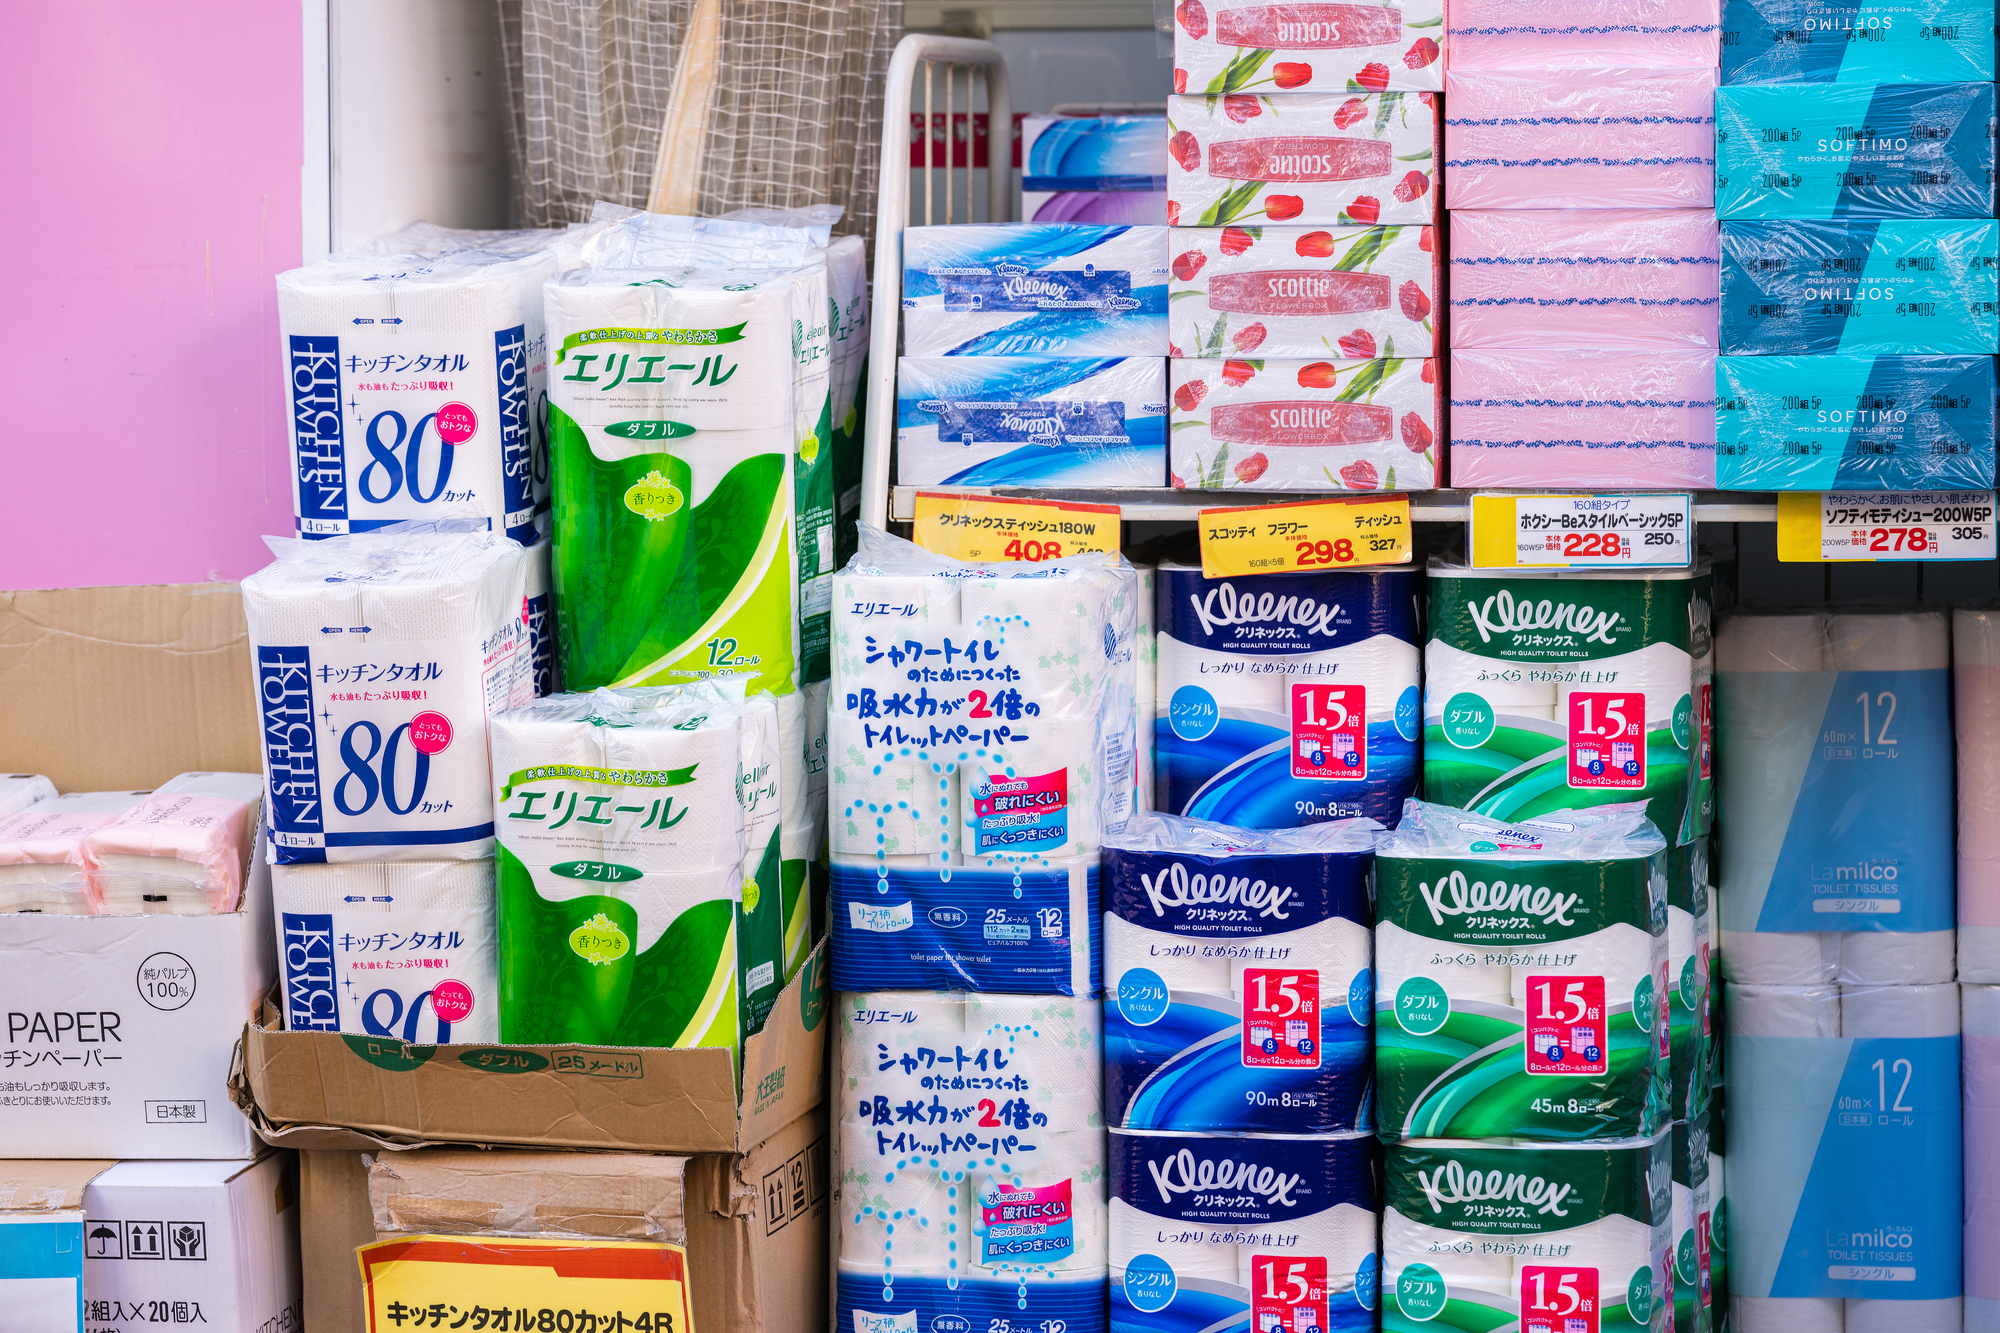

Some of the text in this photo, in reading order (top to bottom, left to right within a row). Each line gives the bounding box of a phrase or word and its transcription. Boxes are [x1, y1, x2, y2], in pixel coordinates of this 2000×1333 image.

[1804, 17, 1892, 30] SOFTIMO
[1818, 139, 1908, 151] SOFTIMO
[1003, 277, 1070, 301] Kleenex
[1805, 288, 1894, 300] SOFTIMO
[344, 354, 470, 374] キッチンタオル
[562, 354, 738, 392] エリエール
[358, 381, 454, 391] 水も油もたっぷり吸収！
[292, 342, 321, 484] TOWELS
[444, 412, 468, 422] とっても
[1817, 410, 1907, 423] SOFTIMO
[311, 349, 344, 512] KITCHEN
[440, 420, 472, 432] おトクな
[627, 422, 675, 436] ダブル
[1000, 412, 1065, 435] Kleenex
[1812, 441, 1822, 454] 5P
[358, 410, 455, 504] 80
[442, 489, 476, 502] カット
[633, 492, 675, 506] 香りつき
[1828, 494, 1990, 505] やわらかく、お肌にやさしい肌ざわり
[1573, 499, 1630, 510] 160組タイプ
[1520, 513, 1683, 529] ホクシーBeスタイルベーシック5P
[1826, 507, 1992, 524] ソフティモティシュー200W5P
[306, 521, 340, 532] 4ロール
[940, 513, 1096, 535] クリネックスティッシュ180W
[1209, 514, 1402, 540] スコッティ フラワー ティッシュ
[1644, 532, 1674, 545] 250
[1870, 528, 1928, 551] 278
[1952, 527, 1982, 539] 305
[1004, 539, 1062, 562] 408
[1295, 538, 1354, 566] 298
[1370, 538, 1396, 551] 327
[1545, 543, 1561, 551] 価格
[1563, 533, 1620, 557] 228
[1929, 542, 1938, 553] 円
[1622, 548, 1631, 558] 円
[1248, 557, 1285, 568] 160組×5個
[851, 602, 919, 618] エリエール
[1191, 582, 1341, 636] Kleenex
[1468, 589, 1620, 644] Kleenex
[1234, 627, 1297, 639] クリネックス
[1512, 634, 1574, 647] クリネックス
[865, 636, 1000, 667] シャワートイレ
[316, 662, 443, 684] キッチンタオル
[908, 665, 1021, 683] のためにつくった
[1200, 662, 1339, 675] しっかり なめらか 仕上げ
[1477, 670, 1618, 684] ふっくら やわらか 仕上げ
[330, 690, 427, 702] 水も油もたっぷり吸収！
[847, 687, 1040, 721] 吸水力が2倍の
[1172, 702, 1215, 716] シングル
[1299, 690, 1360, 731] 1.5 倍
[1450, 709, 1486, 724] ダブル
[1577, 698, 1640, 740] 1.5 倍
[1856, 691, 1898, 745] 12
[260, 653, 296, 797] TOWELS
[282, 656, 319, 825] KITCHEN
[414, 730, 447, 742] おトクな
[864, 723, 1029, 748] トイレットペーパー
[1315, 752, 1321, 761] 8
[1347, 753, 1357, 762] 12
[1863, 748, 1899, 759] ロール
[333, 720, 430, 817] 80
[1296, 766, 1362, 777] 8ロールで12ロール分の長さ
[979, 782, 1028, 795] 水にぬれても
[419, 801, 453, 813] カット
[994, 791, 1060, 811] 破れにくい
[508, 790, 689, 830] エリエール
[982, 813, 1040, 829] たっぷり吸水！
[280, 834, 316, 846] 4ロール
[982, 826, 1064, 846] 肌にくっつきにくい
[573, 863, 622, 880] ダブル
[1141, 862, 1292, 919] Kleenex
[1812, 883, 1898, 894] TOILET TISSUES
[1419, 870, 1578, 926] Kleenex
[857, 907, 891, 920] リーフ柄
[1186, 907, 1248, 921] クリネックス
[1834, 901, 1880, 912] シングル
[934, 912, 961, 922] 無香料
[984, 908, 1029, 923] 25メートル
[1466, 915, 1531, 929] クリネックス
[867, 919, 910, 930] プリントロール
[338, 931, 465, 952] キッチンタオル
[577, 935, 622, 950] 香りつき
[910, 953, 992, 963] toilet paper for shower toilet
[143, 967, 189, 981] 純パルプ
[147, 983, 189, 999] 100%
[1120, 986, 1165, 1000] シングル
[1251, 974, 1313, 1018] 1.5 倍
[1129, 1004, 1154, 1012] 香りなし
[1402, 995, 1439, 1010] ダブル
[854, 1009, 918, 1025] エリエール
[8, 1012, 122, 1043] PAPER
[0, 1049, 122, 1068] チンペーパー
[478, 1054, 530, 1068] ダブル
[877, 1044, 1008, 1075] シャワートイレ
[920, 1074, 1029, 1091] のためにつくった
[1246, 1091, 1279, 1107] 90m
[1530, 1098, 1565, 1114] 45m
[156, 1104, 196, 1119] 日本製
[859, 1095, 1048, 1130] 吸水力が2倍の
[1878, 1115, 1914, 1126] ロール
[877, 1131, 1036, 1156] トイレットペーパー
[791, 1161, 803, 1191] 12
[1148, 1148, 1300, 1207] Kleenex
[1418, 1160, 1571, 1216] Kleenex
[1194, 1194, 1255, 1207] クリネックス
[1002, 1201, 1066, 1221] 破れにくい
[1464, 1204, 1526, 1218] クリネックス
[987, 1237, 1071, 1255] 肌にくっつきにくい
[1127, 1271, 1172, 1286] シングル
[1849, 1268, 1895, 1280] シングル
[1260, 1261, 1322, 1304] 1.5 倍
[1402, 1280, 1437, 1295] ダブル
[387, 1301, 673, 1333] キッチンタオル80カット4R
